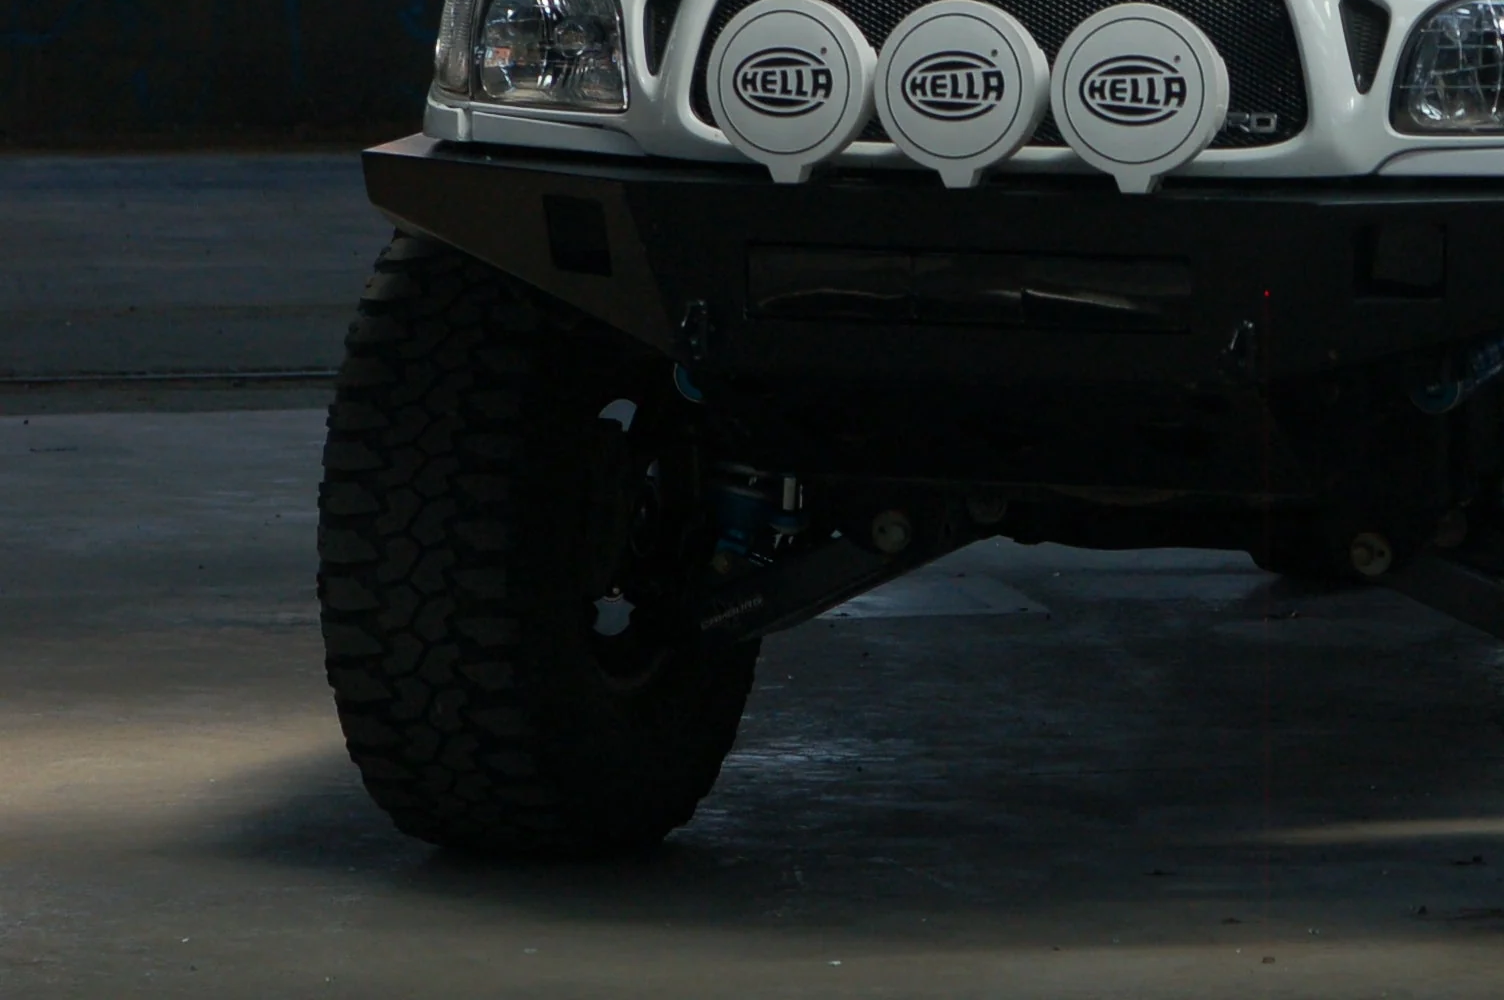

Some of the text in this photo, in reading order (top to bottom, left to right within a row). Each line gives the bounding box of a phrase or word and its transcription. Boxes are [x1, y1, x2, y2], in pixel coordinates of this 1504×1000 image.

[741, 68, 832, 99] HELLA
[910, 71, 1004, 101] HELLA
[1088, 77, 1186, 107] HELLA
[1226, 112, 1278, 133] RD
